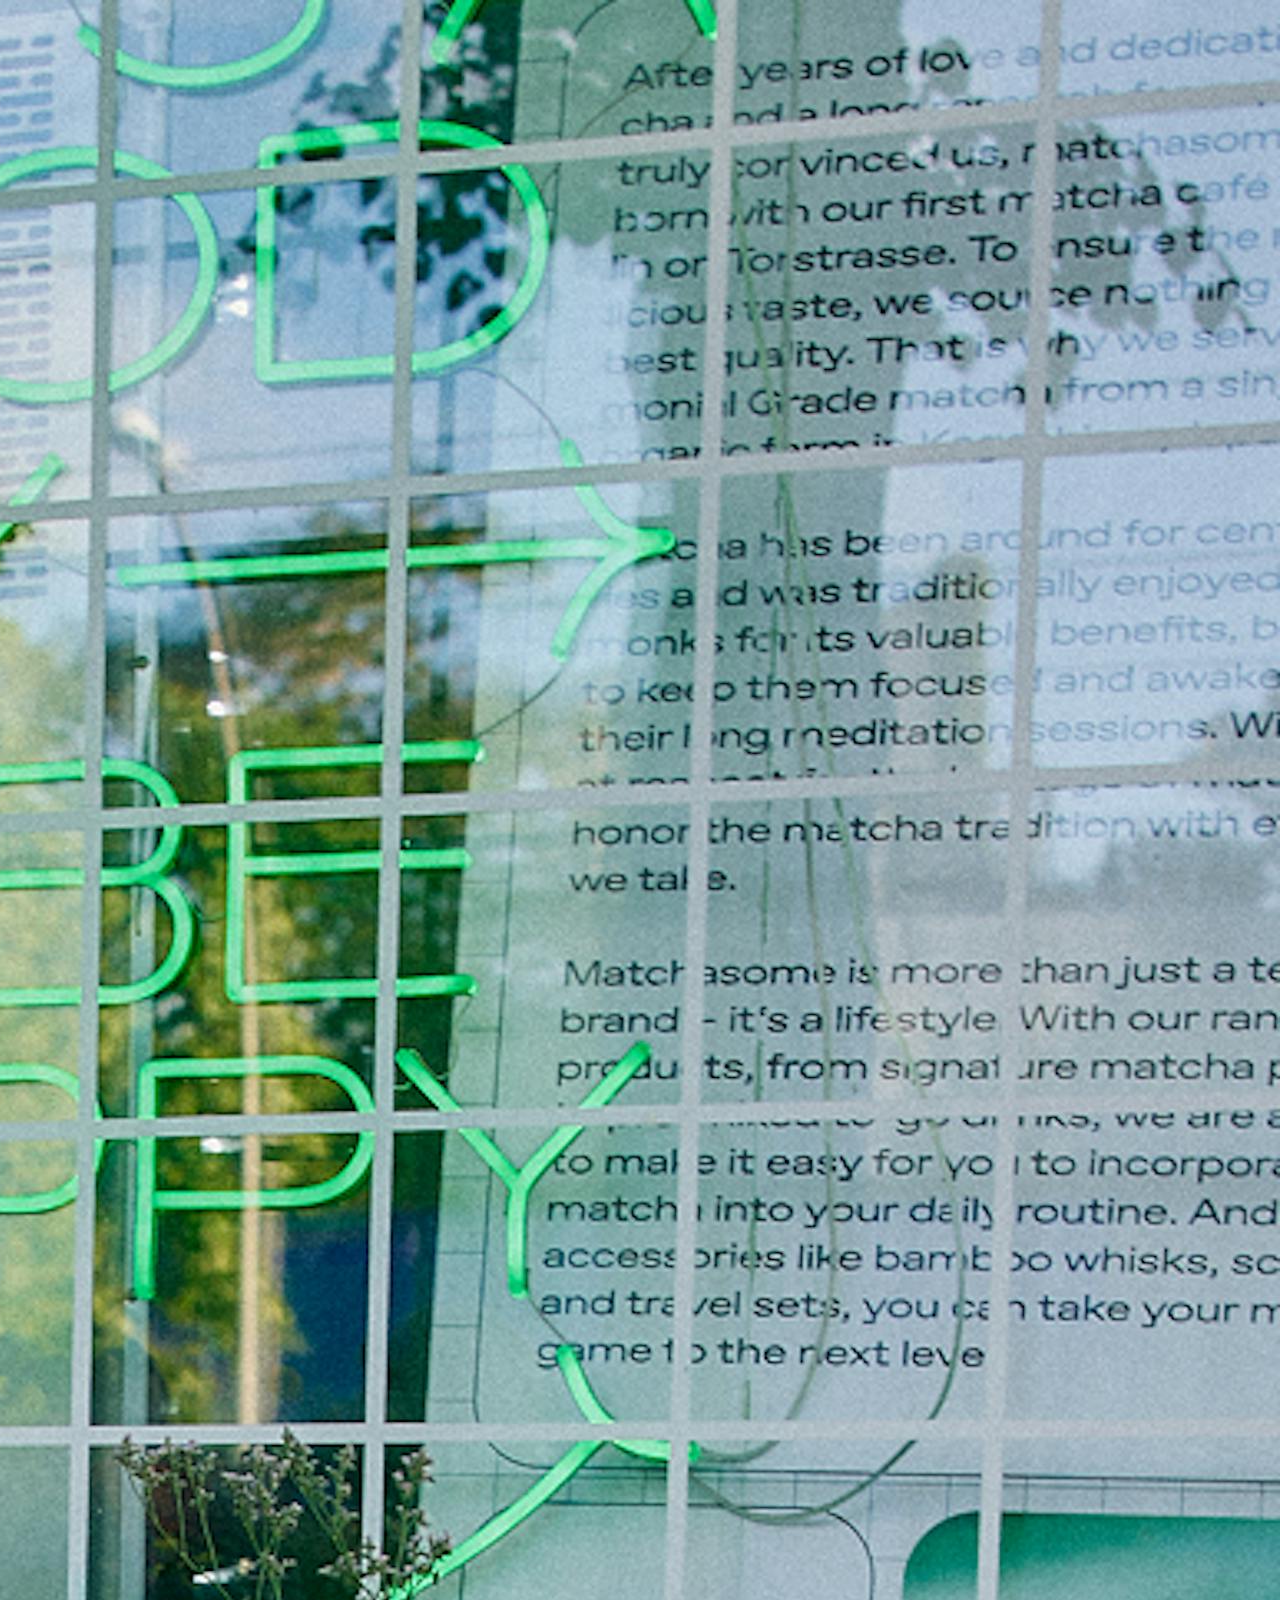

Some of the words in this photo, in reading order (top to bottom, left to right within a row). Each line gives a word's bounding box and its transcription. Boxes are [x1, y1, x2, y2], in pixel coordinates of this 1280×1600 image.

[623, 60, 715, 90] Afte
[866, 47, 909, 76] of
[1017, 35, 1097, 67] ad
[616, 156, 710, 189] truly
[614, 205, 708, 233] born
[822, 199, 891, 223] our
[904, 188, 986, 219] first
[968, 233, 1019, 262] To
[1056, 230, 1176, 259] nsure
[873, 292, 933, 316] we
[845, 527, 948, 557] been
[1124, 519, 1184, 547] for
[670, 579, 748, 608] ad
[745, 674, 858, 700] them
[683, 721, 771, 756] lng
[573, 818, 690, 847] honor
[709, 816, 771, 844] the
[1146, 808, 1240, 838] with
[569, 869, 628, 892] we
[847, 956, 878, 985] is
[891, 962, 1003, 986] more
[1114, 956, 1203, 991] just
[1212, 961, 1237, 984] a
[561, 1005, 679, 1034] brand
[799, 1012, 823, 1034] a
[1018, 1004, 1115, 1032] With
[1127, 1010, 1201, 1032] our
[766, 1052, 868, 1081] from
[1090, 1052, 1255, 1081] matcha
[552, 1150, 593, 1175] to
[728, 1148, 755, 1175] it
[766, 1152, 863, 1182] easy
[872, 1148, 933, 1175] for
[944, 1154, 1020, 1182] yo
[1030, 1150, 1076, 1176] to
[547, 1195, 702, 1223] match
[715, 1195, 793, 1223] into
[1015, 1200, 1178, 1226] routine.
[1189, 1197, 1280, 1226] And
[797, 1243, 862, 1271] like
[1064, 1245, 1220, 1279] whisks,
[540, 1290, 615, 1316] and
[753, 1292, 851, 1324] sets,
[861, 1298, 940, 1325] you
[1040, 1294, 1131, 1322] take
[1140, 1301, 1240, 1328] your
[716, 1338, 795, 1365] the
[798, 1340, 892, 1366] next
